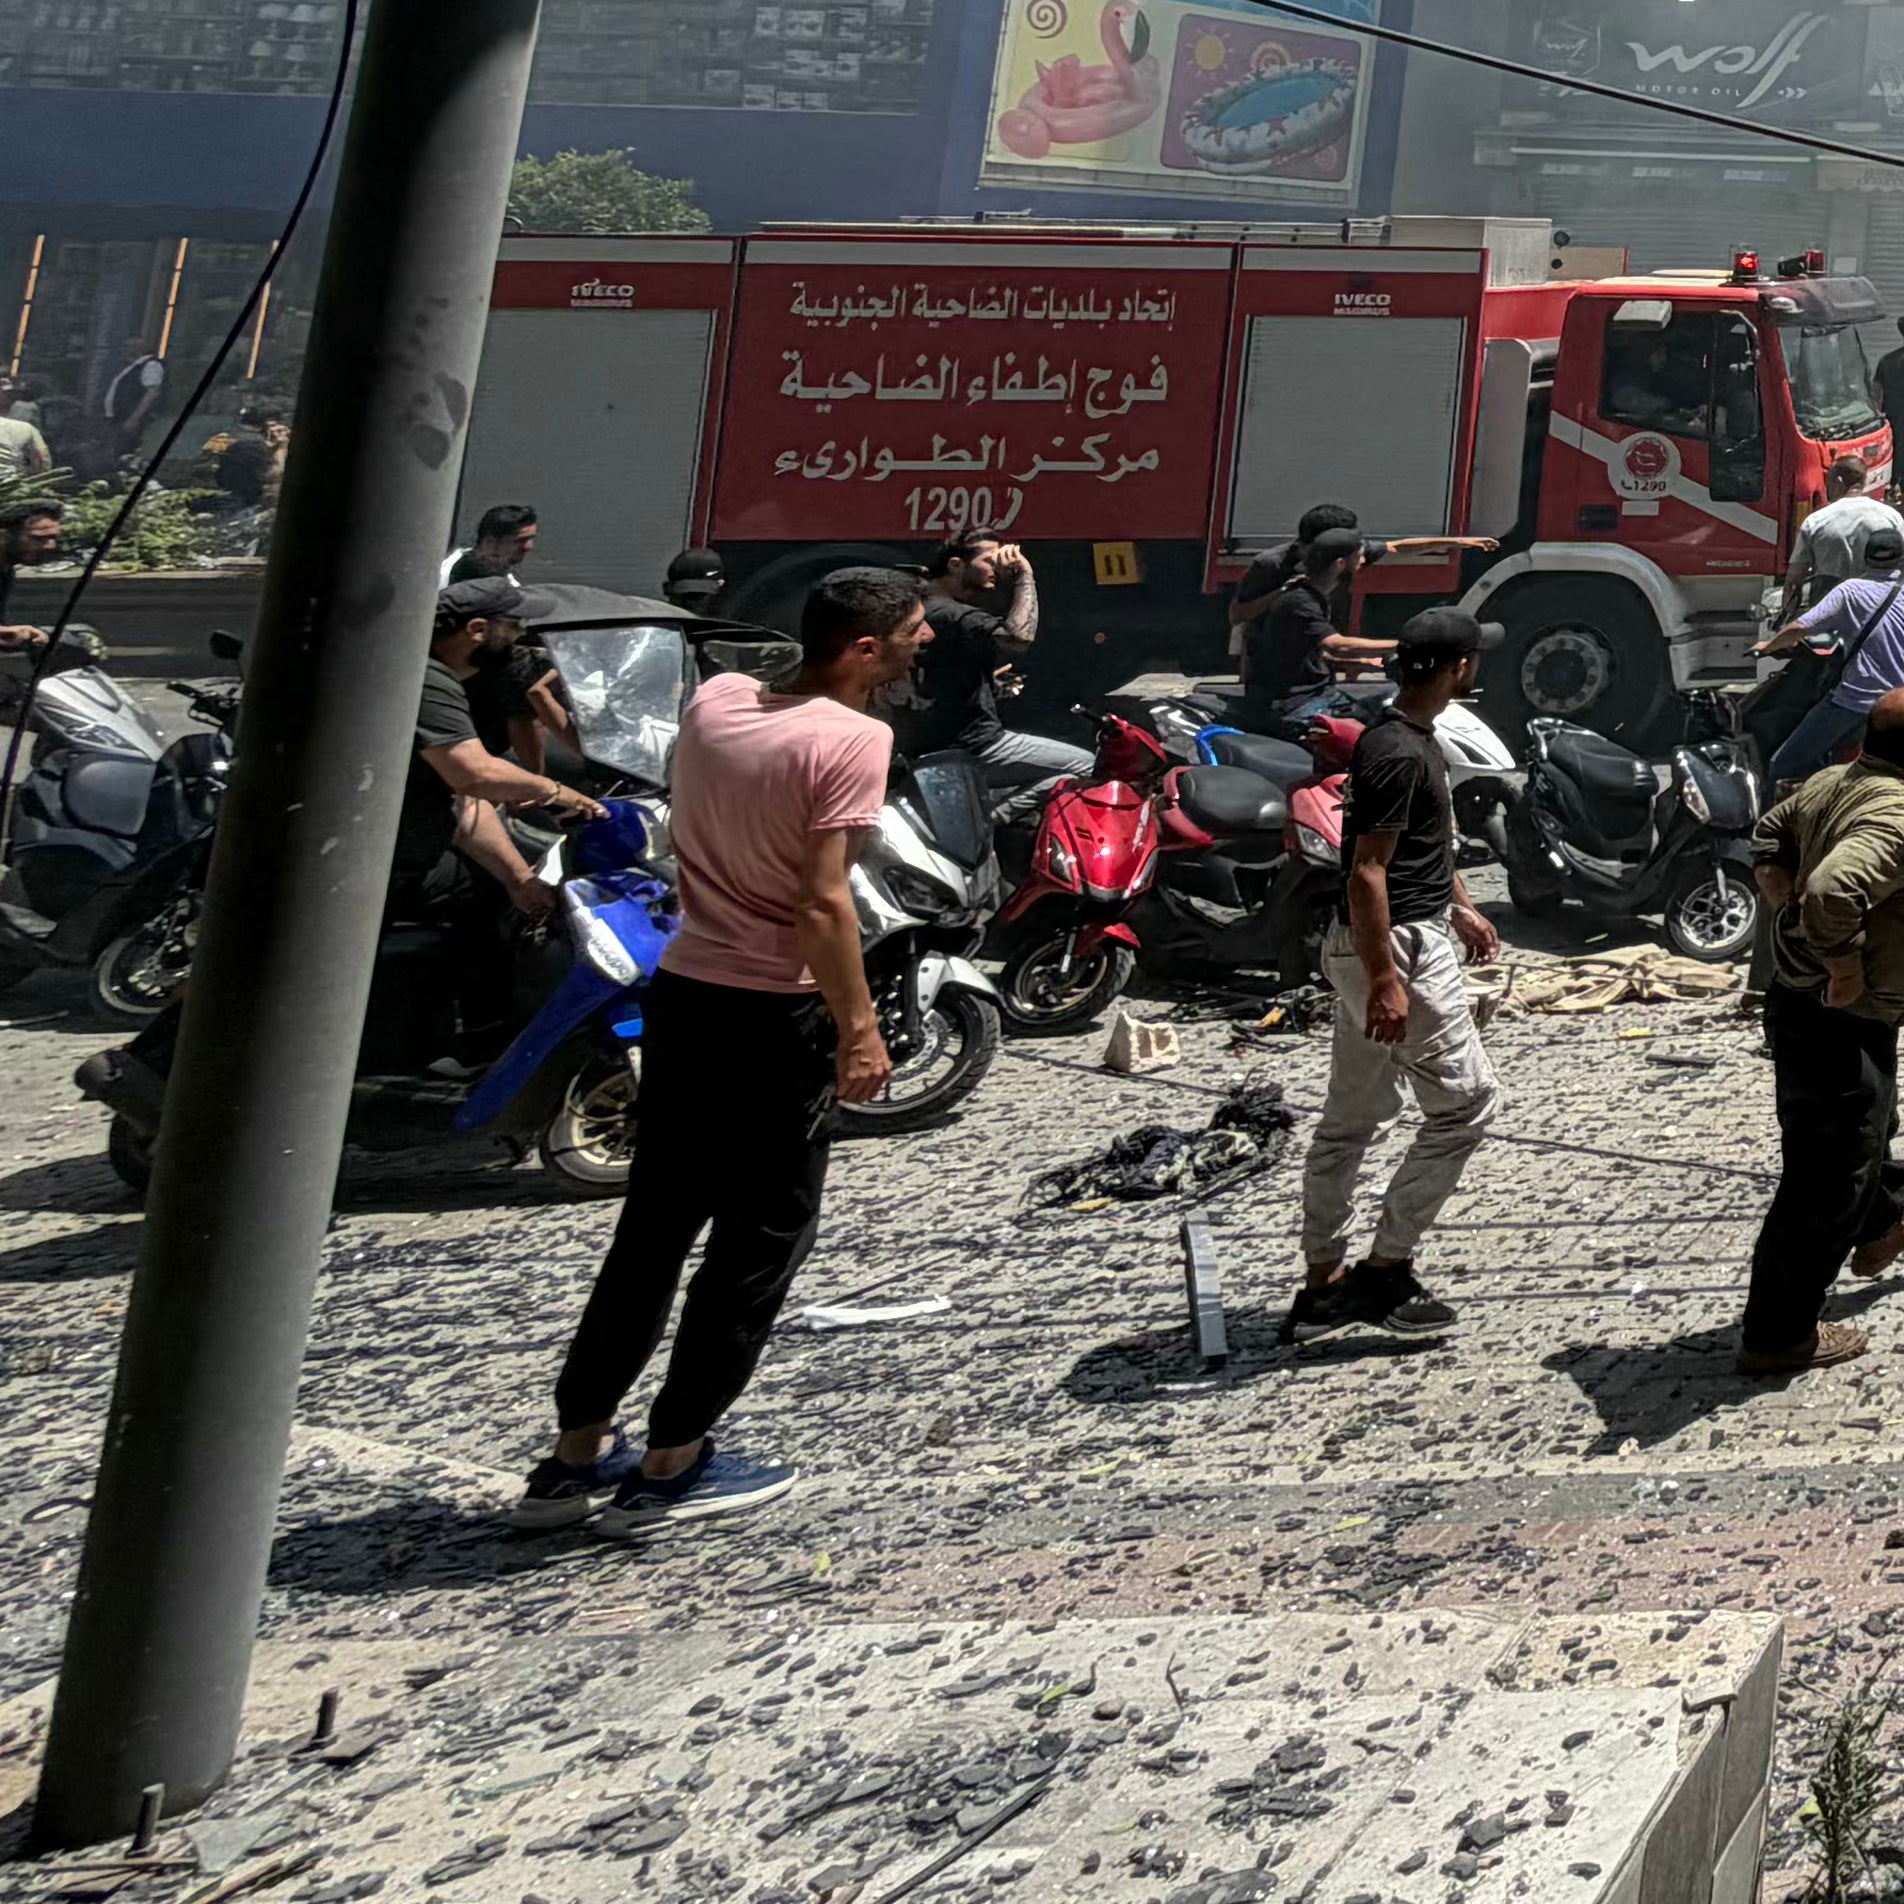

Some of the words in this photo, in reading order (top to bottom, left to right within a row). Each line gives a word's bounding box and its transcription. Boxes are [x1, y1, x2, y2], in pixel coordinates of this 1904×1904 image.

[1635, 83, 1700, 95] MOTOR
[1711, 86, 1742, 97] OIL
[790, 281, 907, 331] الجنوبية
[912, 283, 1018, 328] الضاحية
[1024, 286, 1113, 329] بلديات
[1334, 293, 1392, 306] IVECO
[779, 349, 960, 413] الضاحية
[966, 351, 1078, 416] إطفاء
[1085, 354, 1169, 418] فوج
[1009, 432, 1160, 482] مركز
[904, 485, 991, 532] 1290
[1633, 479, 1667, 492] 1290
